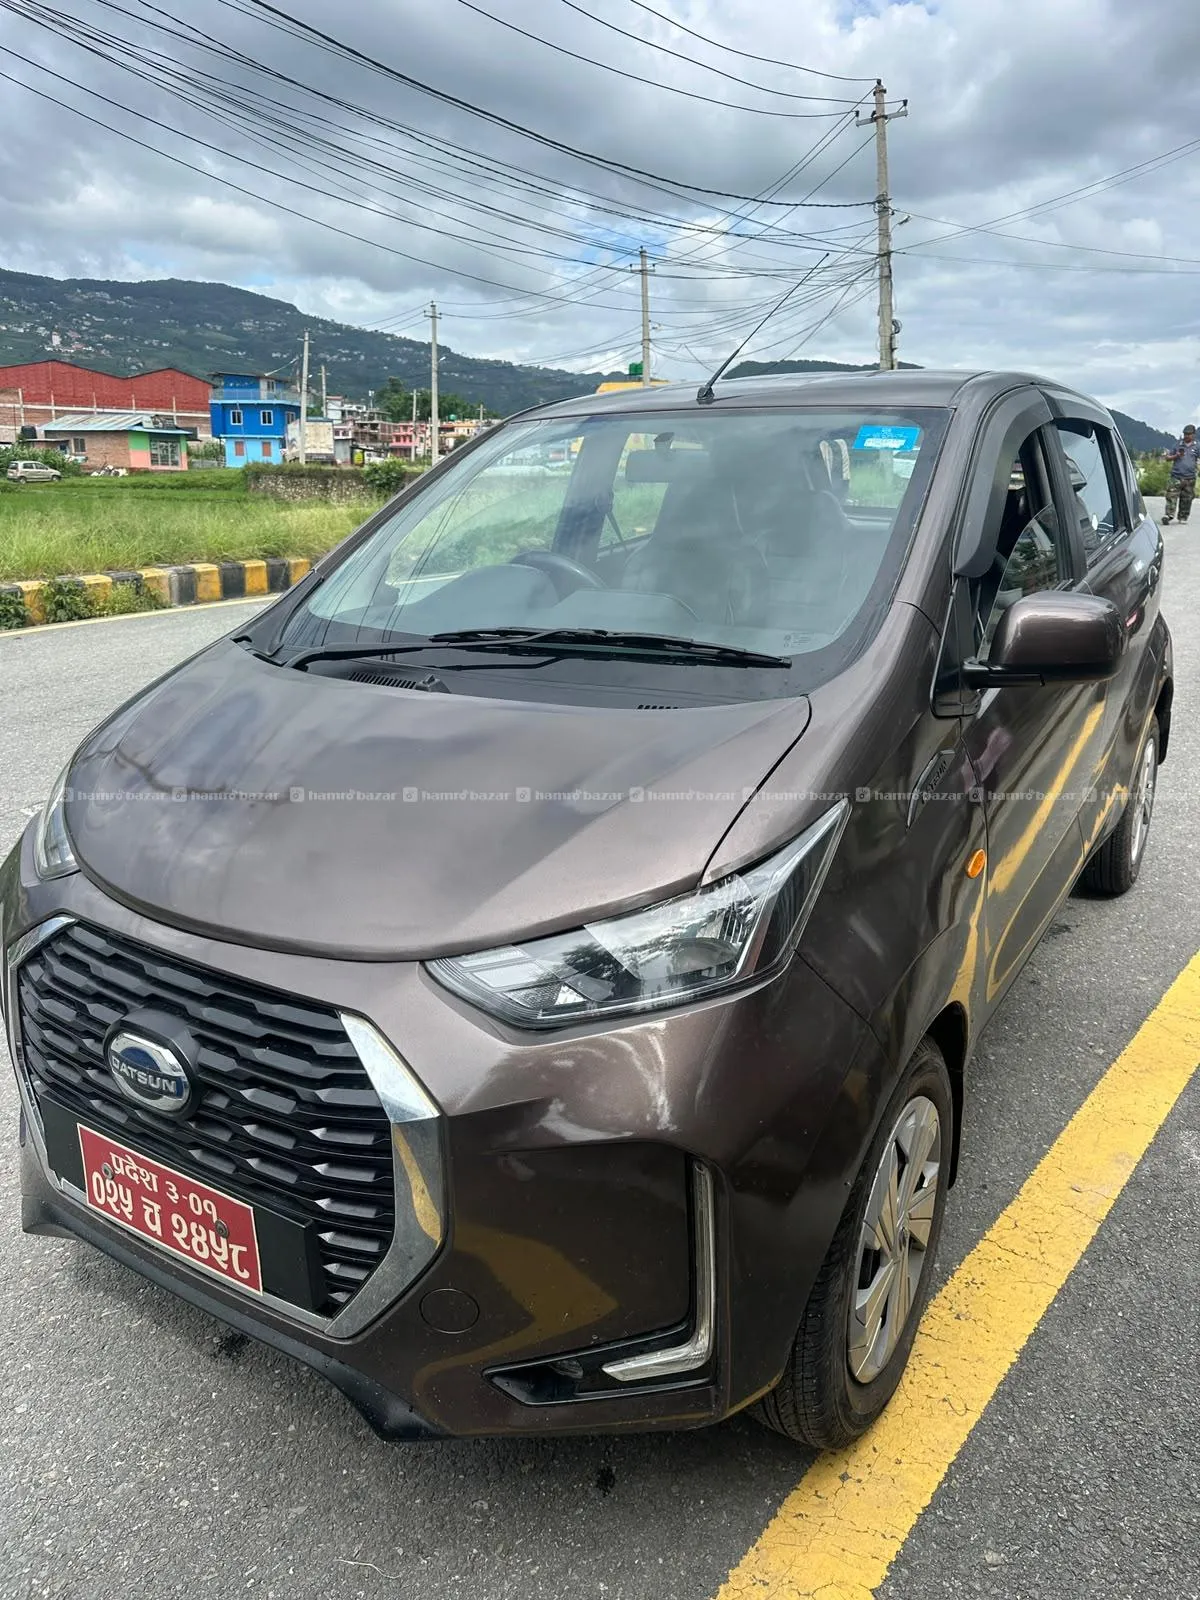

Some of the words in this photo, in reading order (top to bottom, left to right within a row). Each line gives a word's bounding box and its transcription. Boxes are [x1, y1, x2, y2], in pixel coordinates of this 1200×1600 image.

[112, 1055, 176, 1093] DATSUN
[109, 1151, 159, 1193] प्रदेश
[92, 1170, 133, 1221] ०२५
[140, 1195, 162, 1237] च
[171, 1212, 250, 1279] २४५८
